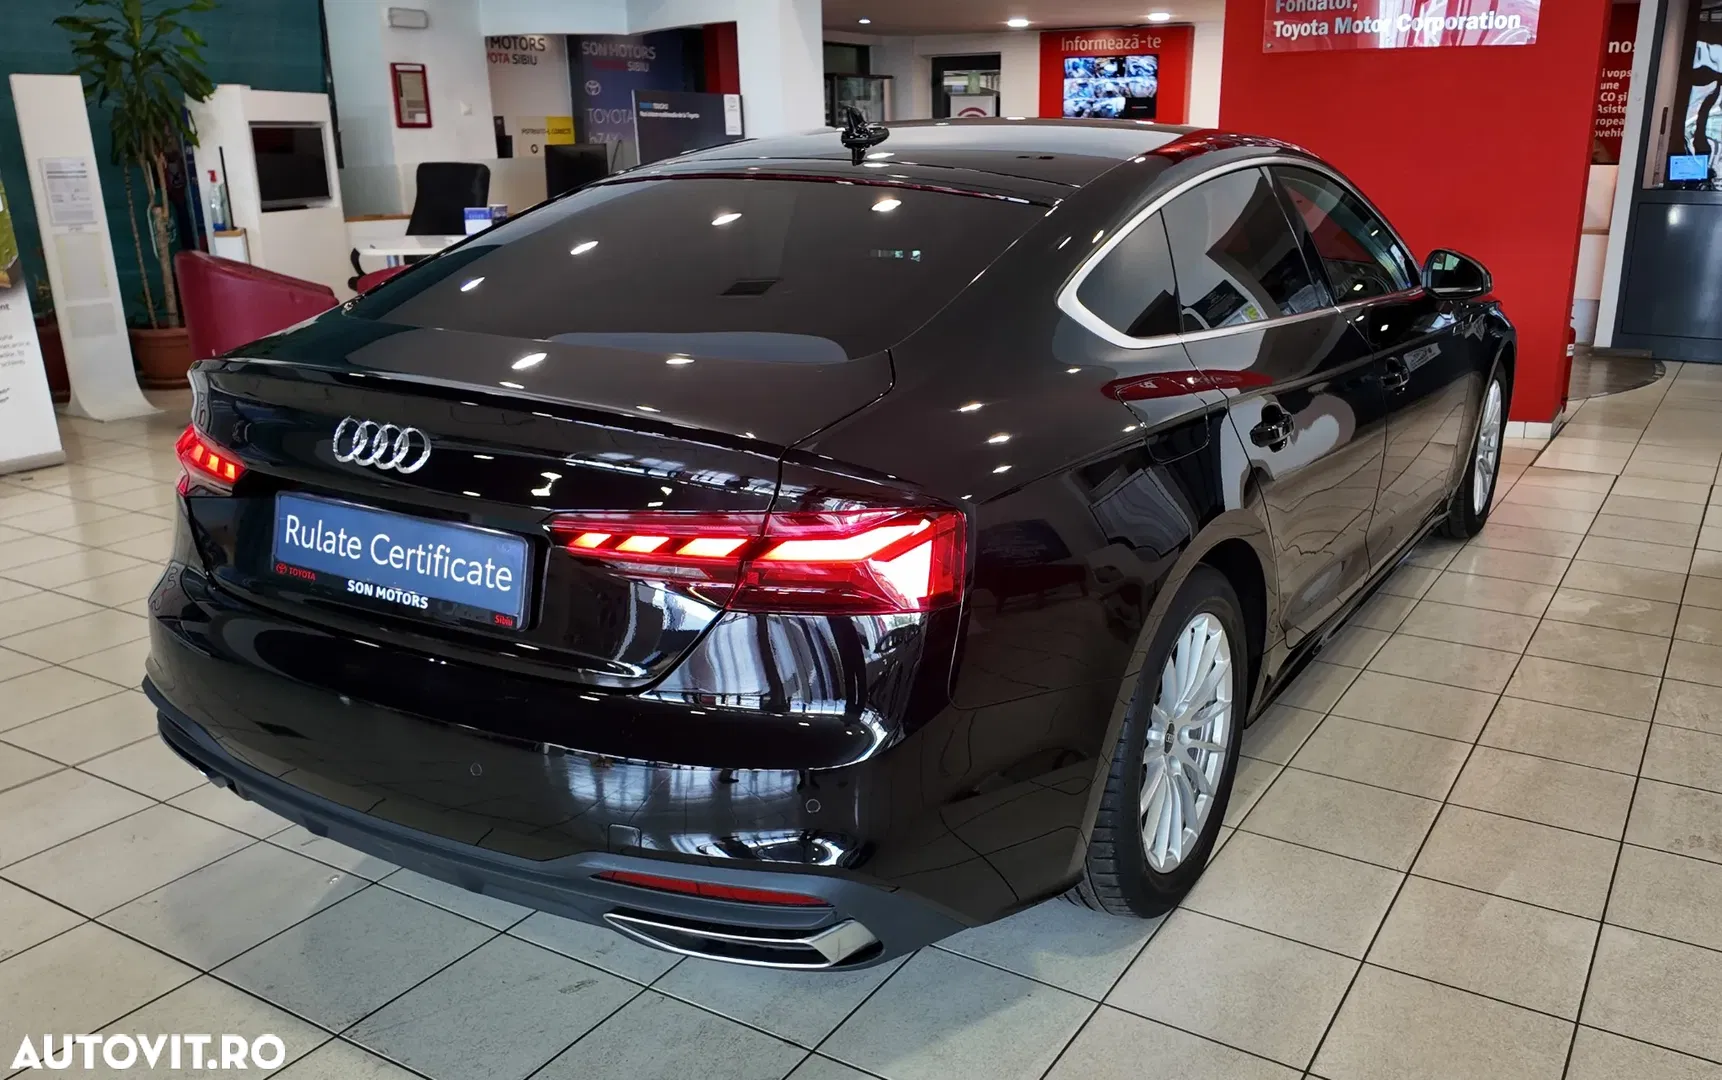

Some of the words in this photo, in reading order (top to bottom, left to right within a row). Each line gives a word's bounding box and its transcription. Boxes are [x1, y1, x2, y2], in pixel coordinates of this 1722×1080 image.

[1274, 19, 1328, 40] Toyota
[1334, 16, 1392, 34] Motor
[1398, 10, 1522, 36] Corporation
[490, 35, 546, 52] MOTORS
[581, 41, 606, 56] SON
[608, 43, 656, 60] MOTORS
[512, 53, 538, 66] SIBIU
[587, 107, 634, 125] TOYOTA
[285, 514, 362, 560] Rulate
[370, 533, 513, 592] Certificate
[288, 567, 317, 582] TOYOTA
[347, 579, 374, 597] SON
[375, 585, 429, 610] MOTORS
